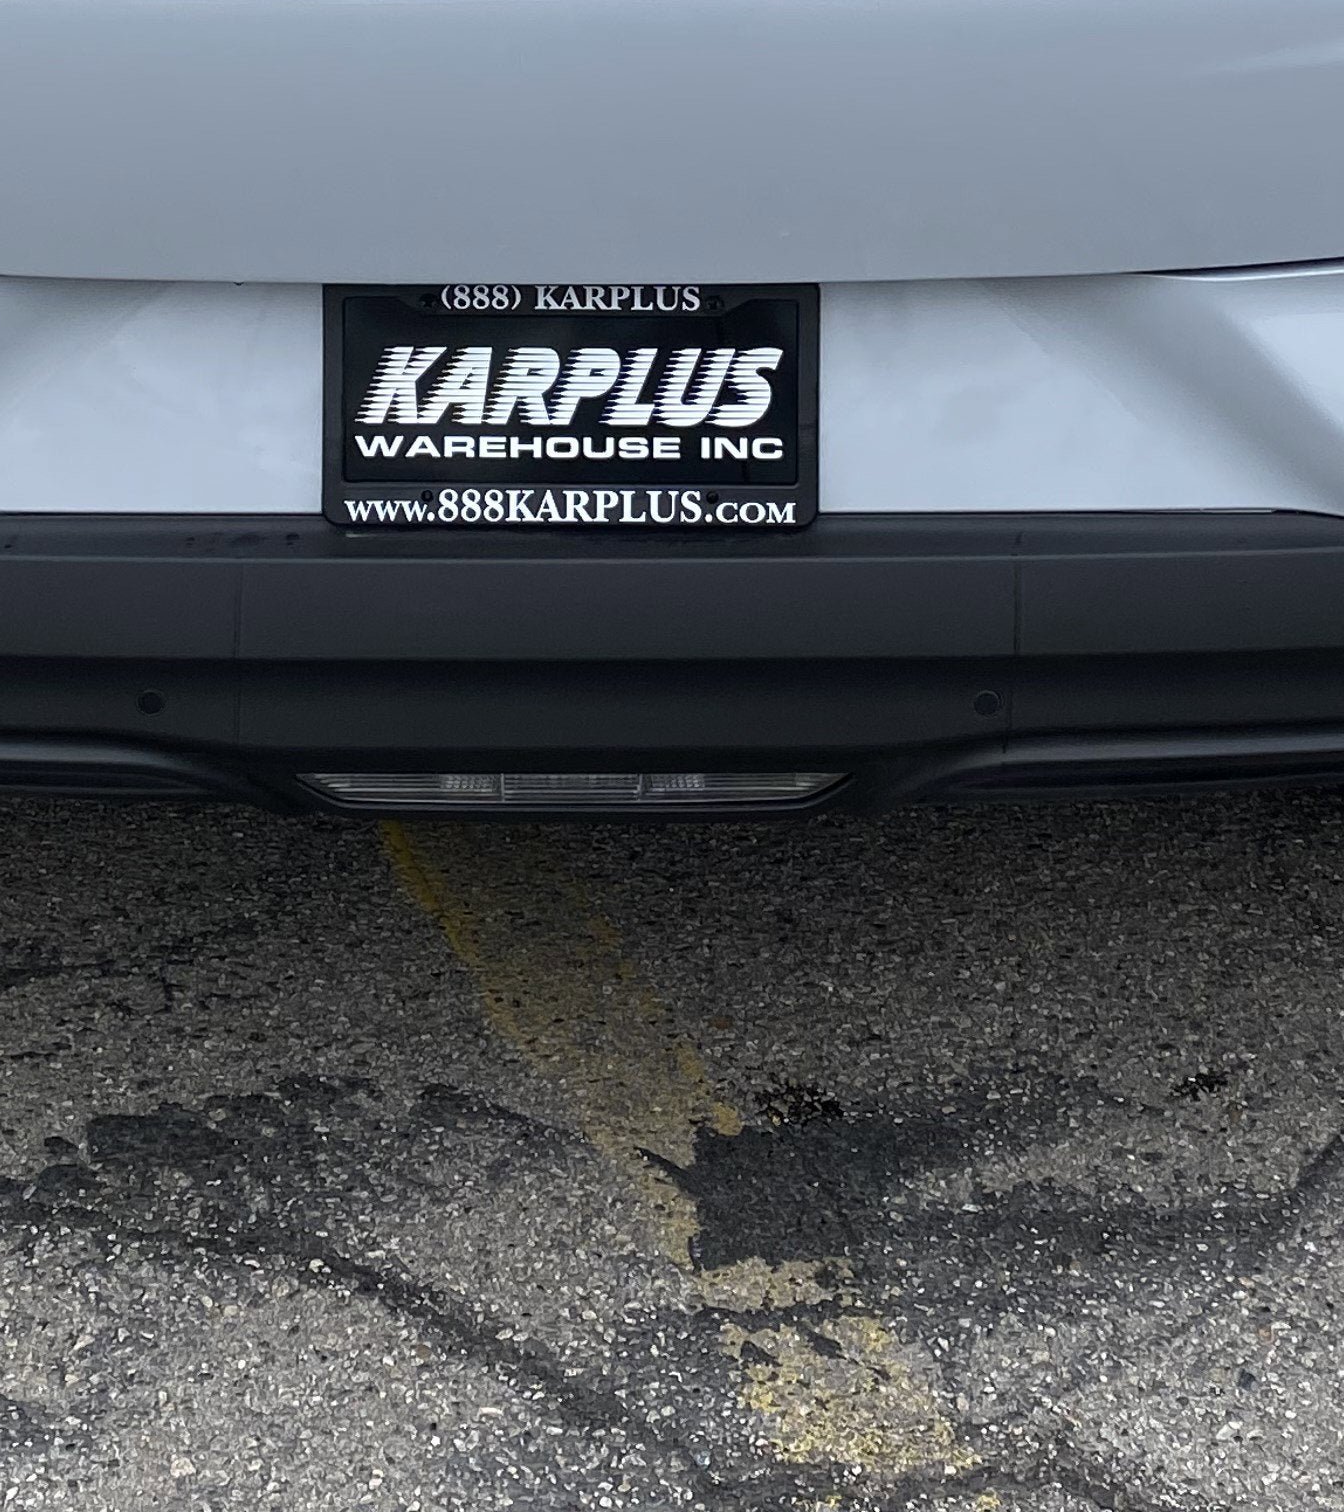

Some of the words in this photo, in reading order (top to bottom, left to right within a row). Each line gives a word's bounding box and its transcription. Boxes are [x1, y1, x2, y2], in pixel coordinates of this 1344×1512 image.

[440, 284, 523, 310] (888)
[534, 285, 701, 311] KARPLUS
[354, 345, 784, 427] KARPLUS
[354, 435, 682, 460] WAREHOUSE
[700, 436, 784, 460] INC
